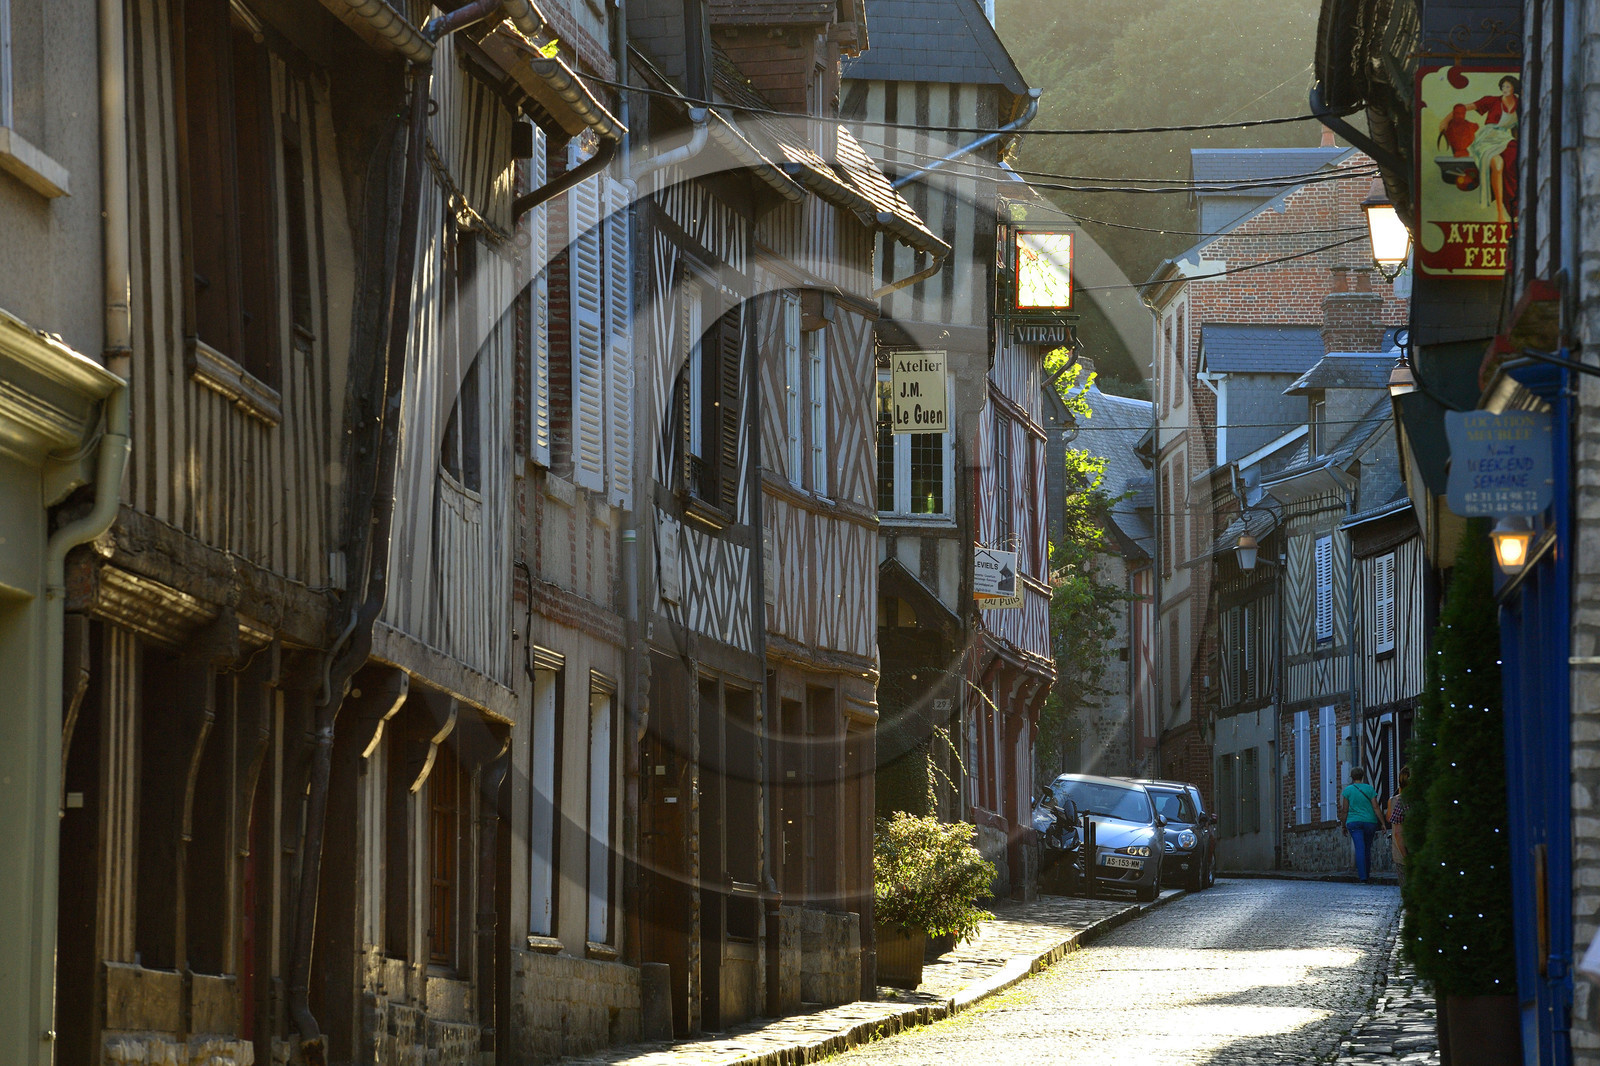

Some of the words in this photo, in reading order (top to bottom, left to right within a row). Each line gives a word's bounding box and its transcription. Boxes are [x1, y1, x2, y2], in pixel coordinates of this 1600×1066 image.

[1016, 326, 1074, 342] VITRAUX
[896, 359, 942, 372] Atelier
[900, 382, 923, 398] J.M.
[896, 404, 909, 424] Le
[914, 403, 943, 424] Guen
